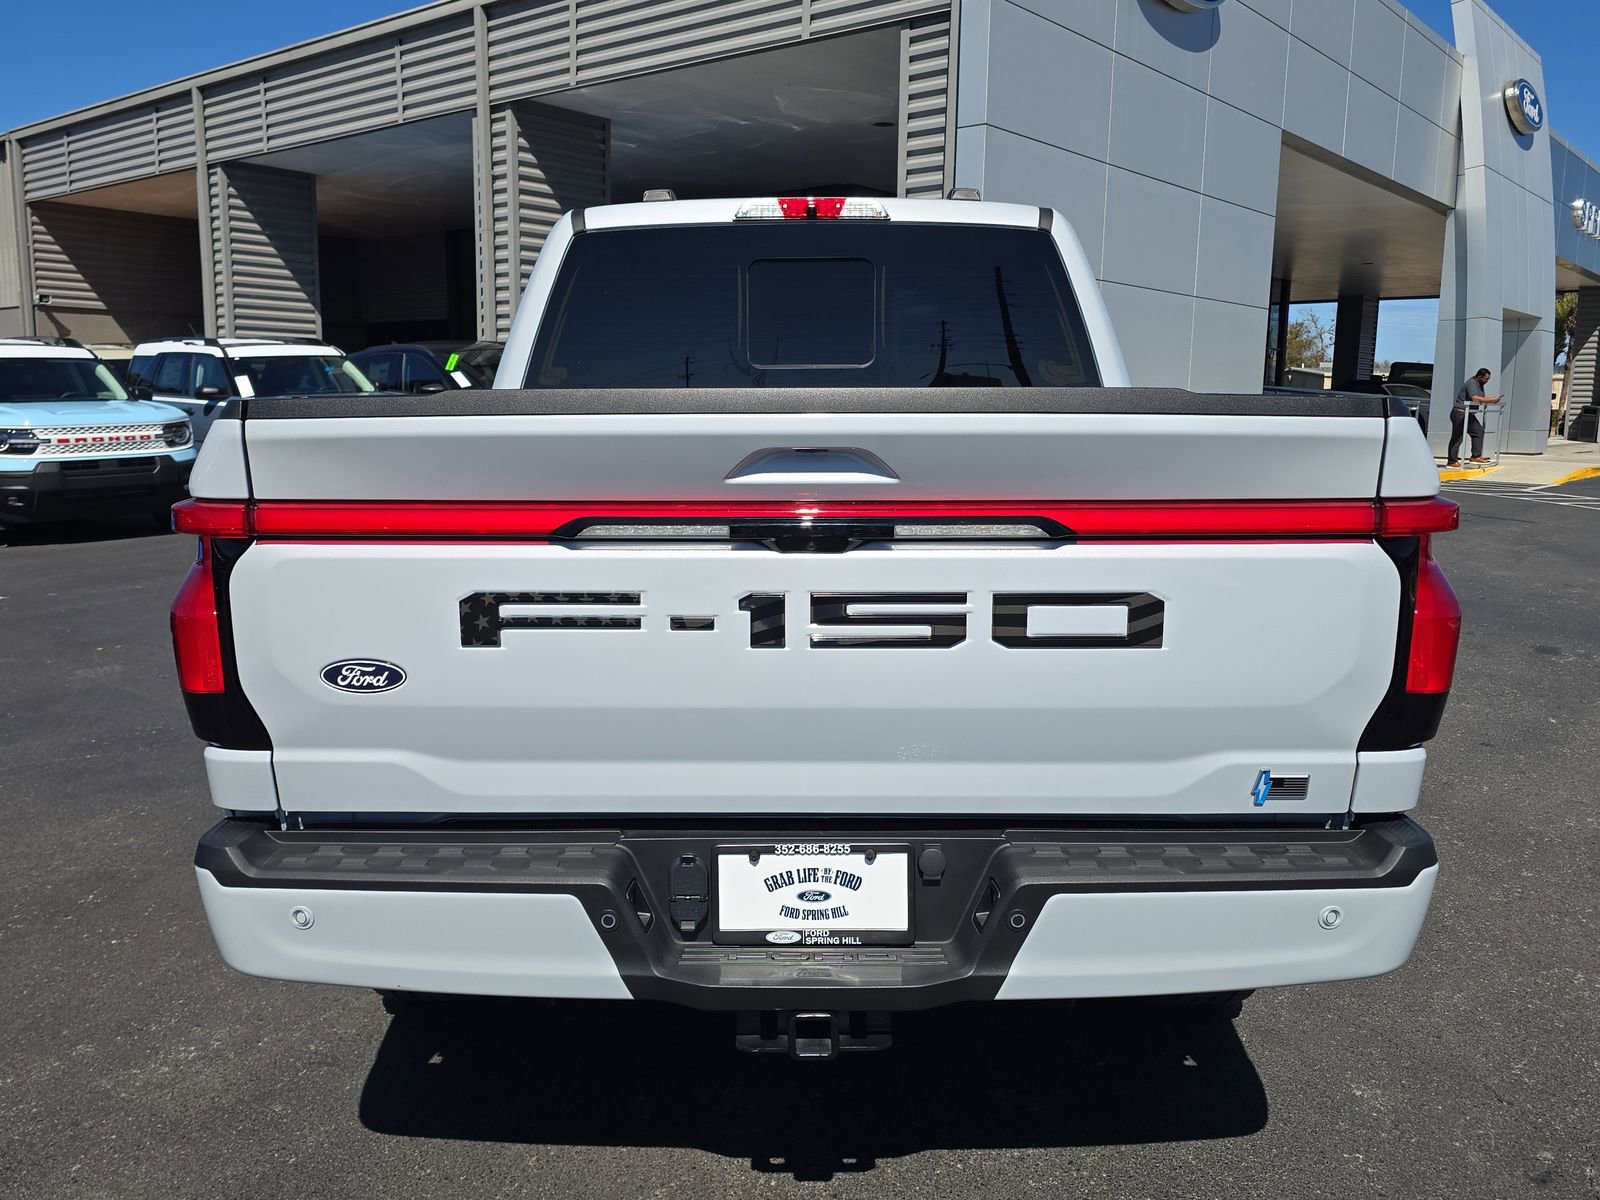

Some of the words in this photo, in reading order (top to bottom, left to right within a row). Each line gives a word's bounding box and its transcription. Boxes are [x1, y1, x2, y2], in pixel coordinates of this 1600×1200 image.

[1523, 88, 1540, 122] Ford
[57, 434, 151, 443] BRONCO
[459, 591, 1165, 648] F-150
[337, 665, 389, 686] Ford
[775, 844, 851, 854] 352-686-8255
[796, 867, 819, 884] LIFE
[823, 867, 832, 875] BY
[763, 870, 795, 893] GRAB
[820, 875, 833, 883] THE
[833, 869, 862, 891] FORD
[802, 891, 825, 901] Ford
[779, 905, 800, 920] FORD
[801, 908, 830, 921] SPRING
[831, 905, 849, 919] HILL
[772, 931, 794, 941] Ford
[805, 937, 840, 945] SPRING
[842, 937, 862, 945] HILL
